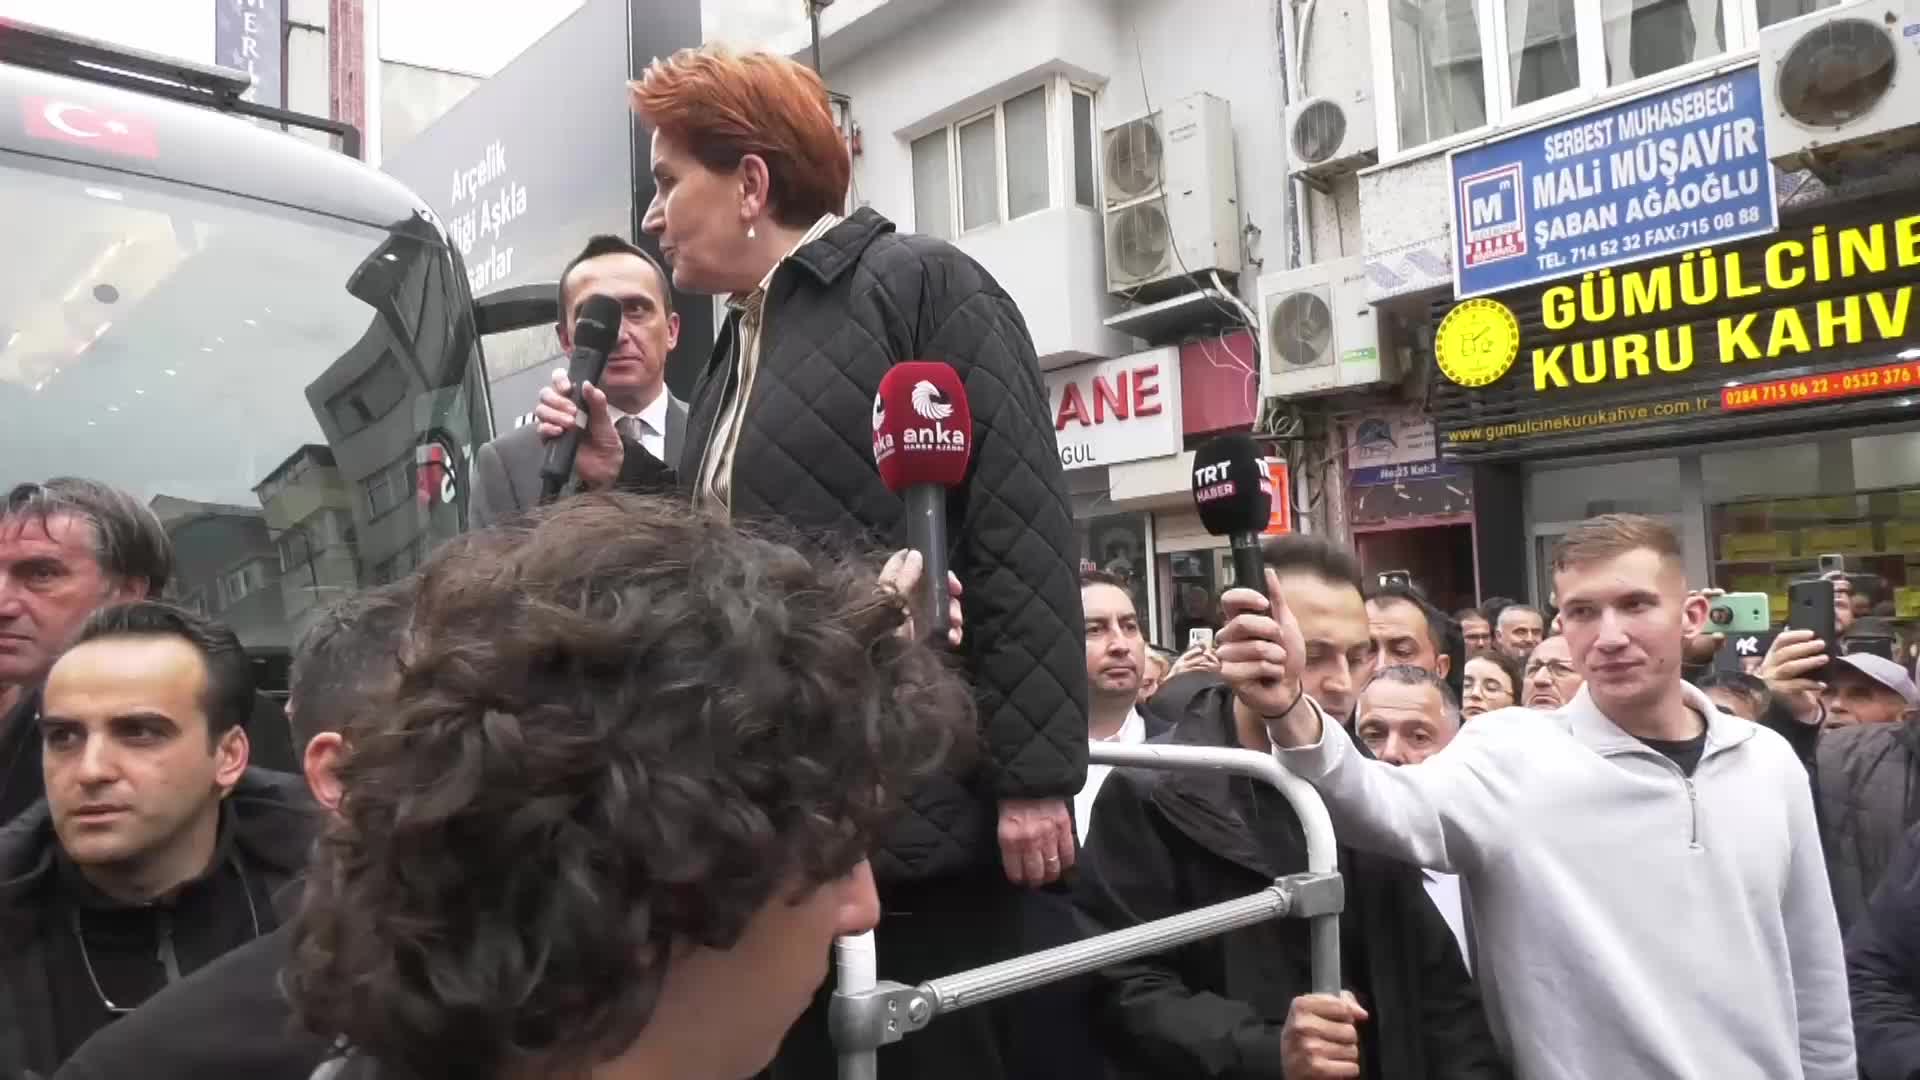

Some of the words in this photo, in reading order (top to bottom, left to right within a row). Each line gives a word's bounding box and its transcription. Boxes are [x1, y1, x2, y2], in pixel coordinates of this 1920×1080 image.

[452, 139, 507, 208] Arçelik
[480, 181, 527, 240] Aşkla
[1534, 202, 1617, 249] ŞABAN
[1625, 167, 1759, 223] AĞAOĞLU
[1570, 244, 1596, 264] 714
[1600, 238, 1618, 256] 52
[1622, 233, 1640, 251] 32
[1714, 211, 1734, 230] 08
[1738, 206, 1760, 225] 88
[1532, 324, 1694, 391] KURU
[1717, 286, 1912, 363] KAHV
[1056, 364, 1162, 430] ANE
[1726, 387, 1758, 405] 0284
[1762, 383, 1787, 400] 715
[1790, 381, 1808, 396] 06
[1812, 379, 1828, 393] 22
[1842, 371, 1879, 389] 0532
[1883, 368, 1911, 384] 376
[903, 421, 965, 446] anka
[1195, 459, 1231, 487] TRT
[1197, 483, 1233, 502] HABER
